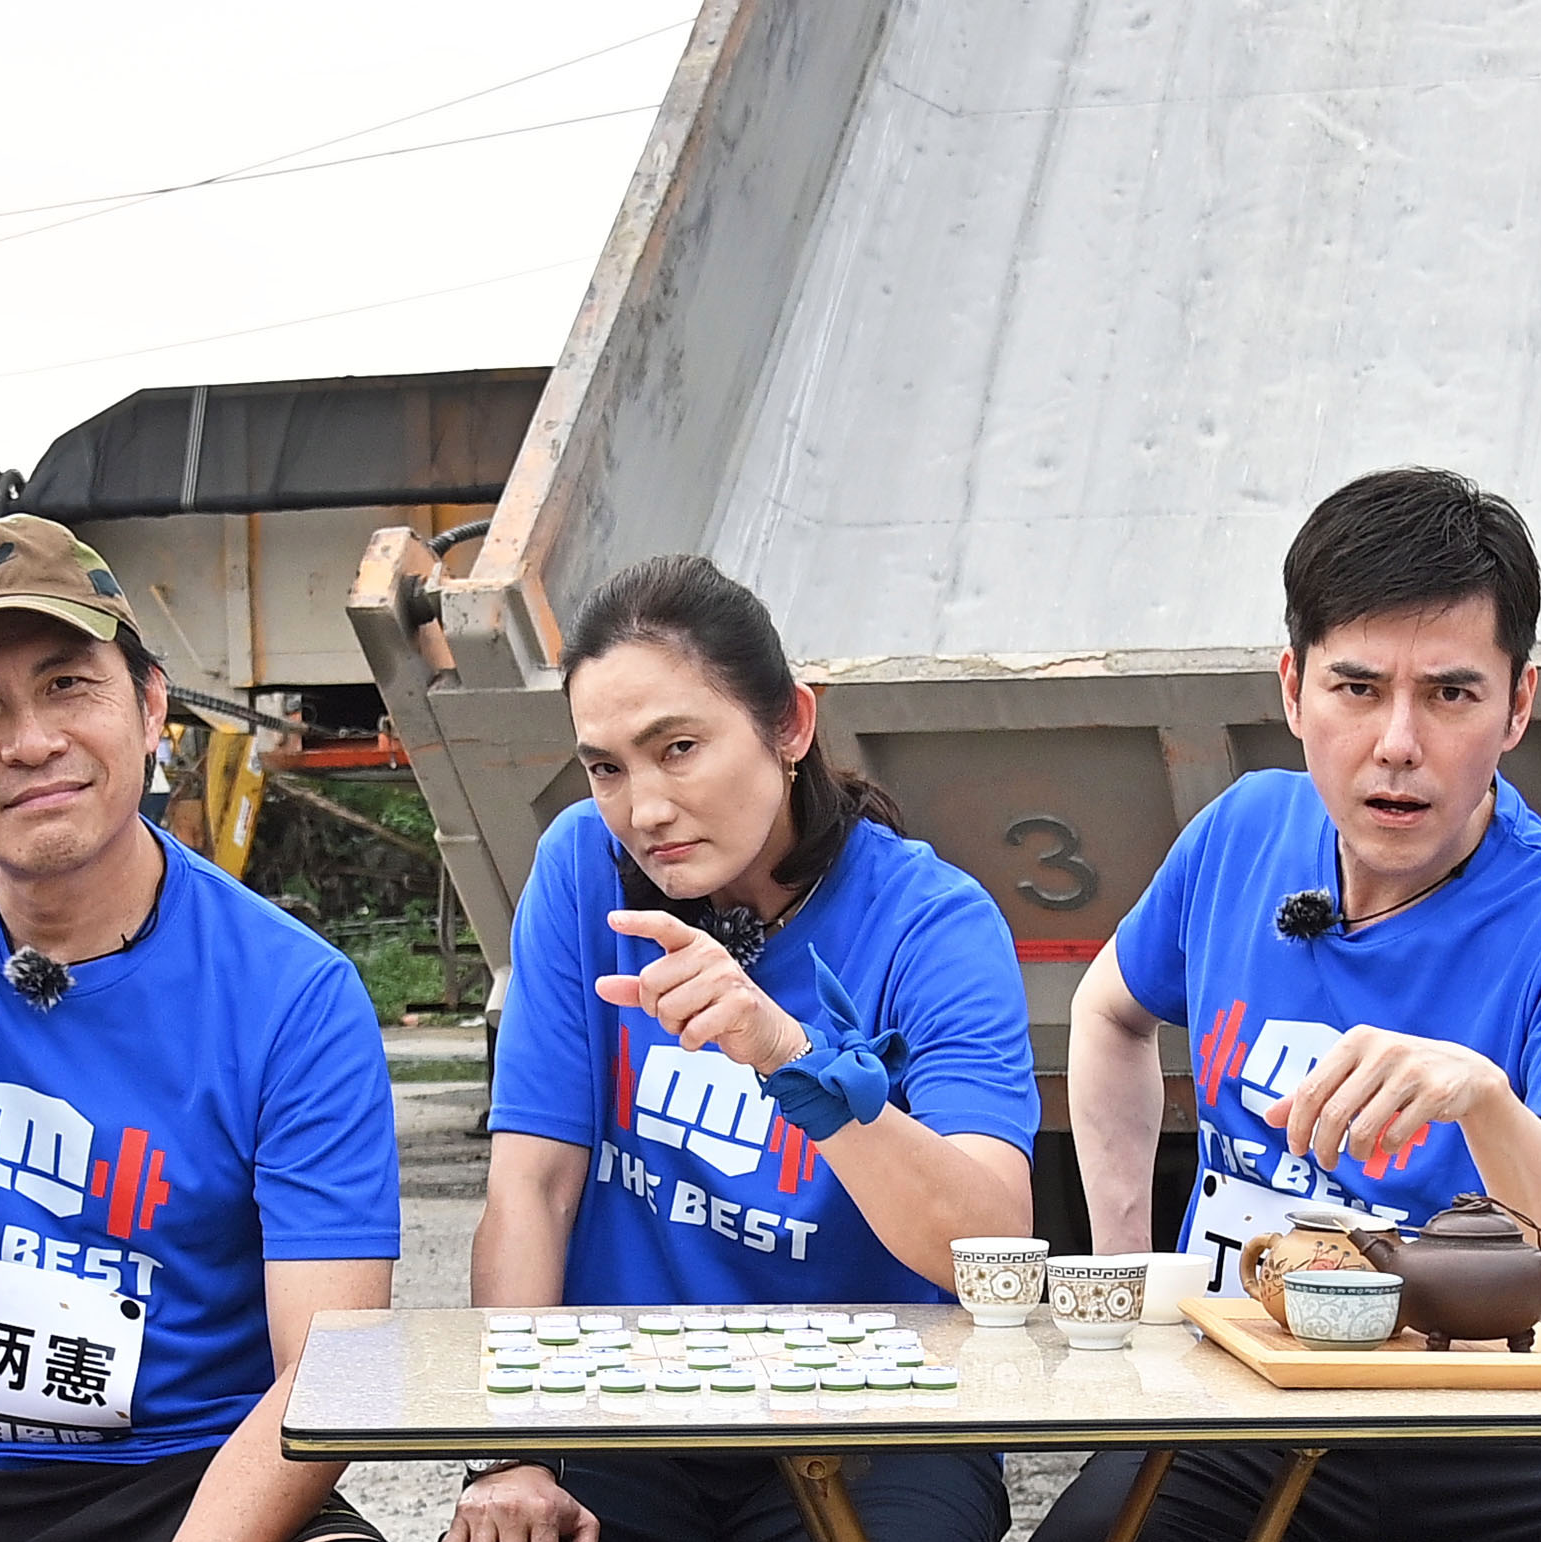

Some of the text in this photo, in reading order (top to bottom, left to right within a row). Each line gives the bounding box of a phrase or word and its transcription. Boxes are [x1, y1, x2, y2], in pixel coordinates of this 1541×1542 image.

[1005, 817, 1098, 911] 3
[596, 1140, 819, 1261] THE BEST
[1199, 1119, 1410, 1226] THE BET
[1, 1225, 164, 1296] BEST
